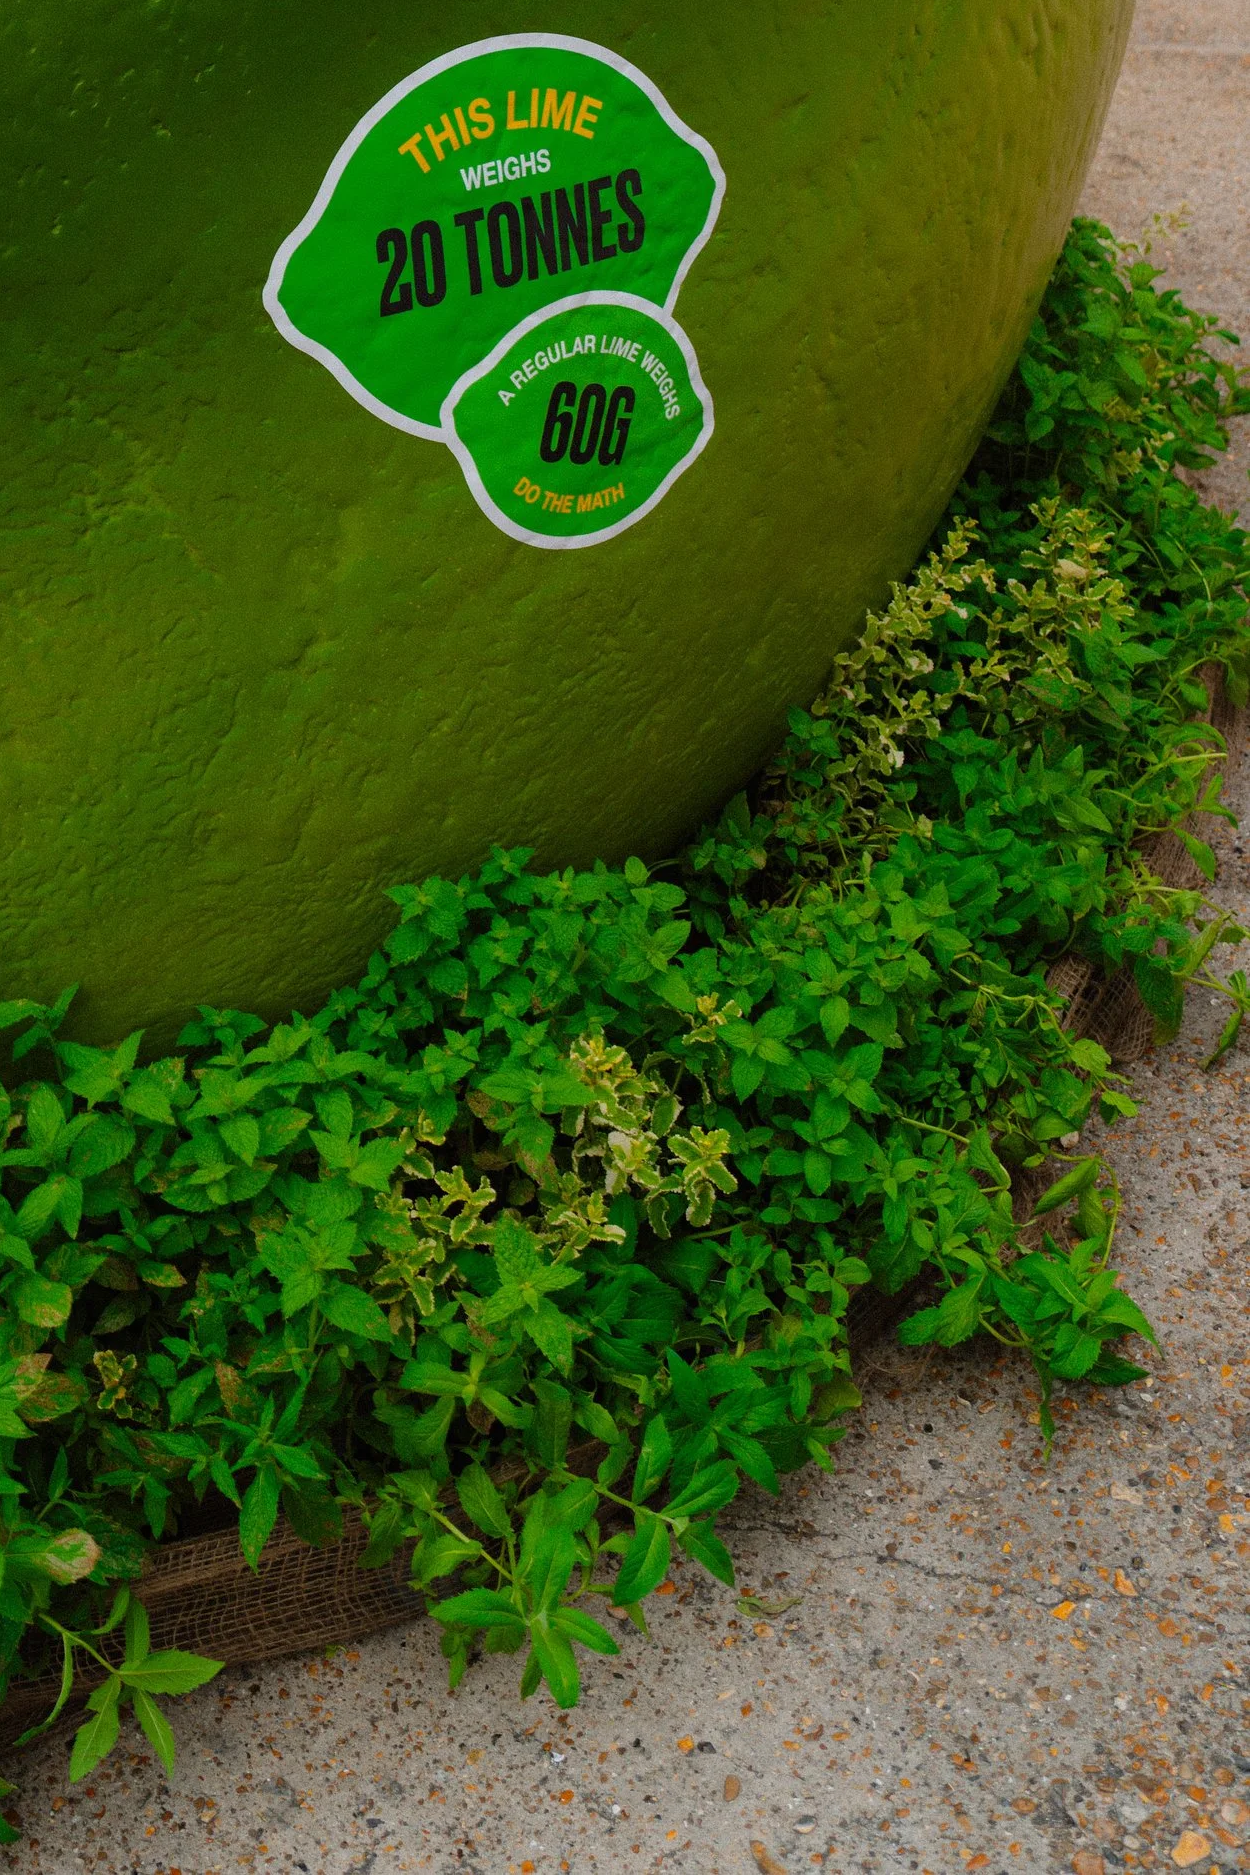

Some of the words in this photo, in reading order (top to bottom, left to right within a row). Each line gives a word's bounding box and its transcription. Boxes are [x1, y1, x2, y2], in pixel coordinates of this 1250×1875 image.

[398, 97, 495, 174] THIS
[506, 88, 603, 140] LIME
[460, 149, 551, 191] WEIGHS
[375, 219, 447, 317] 20
[454, 168, 646, 296] TONNES
[498, 389, 516, 407] A
[510, 334, 597, 390] REGULAR
[600, 335, 642, 363] LIME
[640, 350, 681, 420] WEIGHS
[539, 380, 636, 466] 60G
[513, 476, 542, 504] DO
[541, 491, 575, 514] THE
[576, 482, 626, 514] MATH
